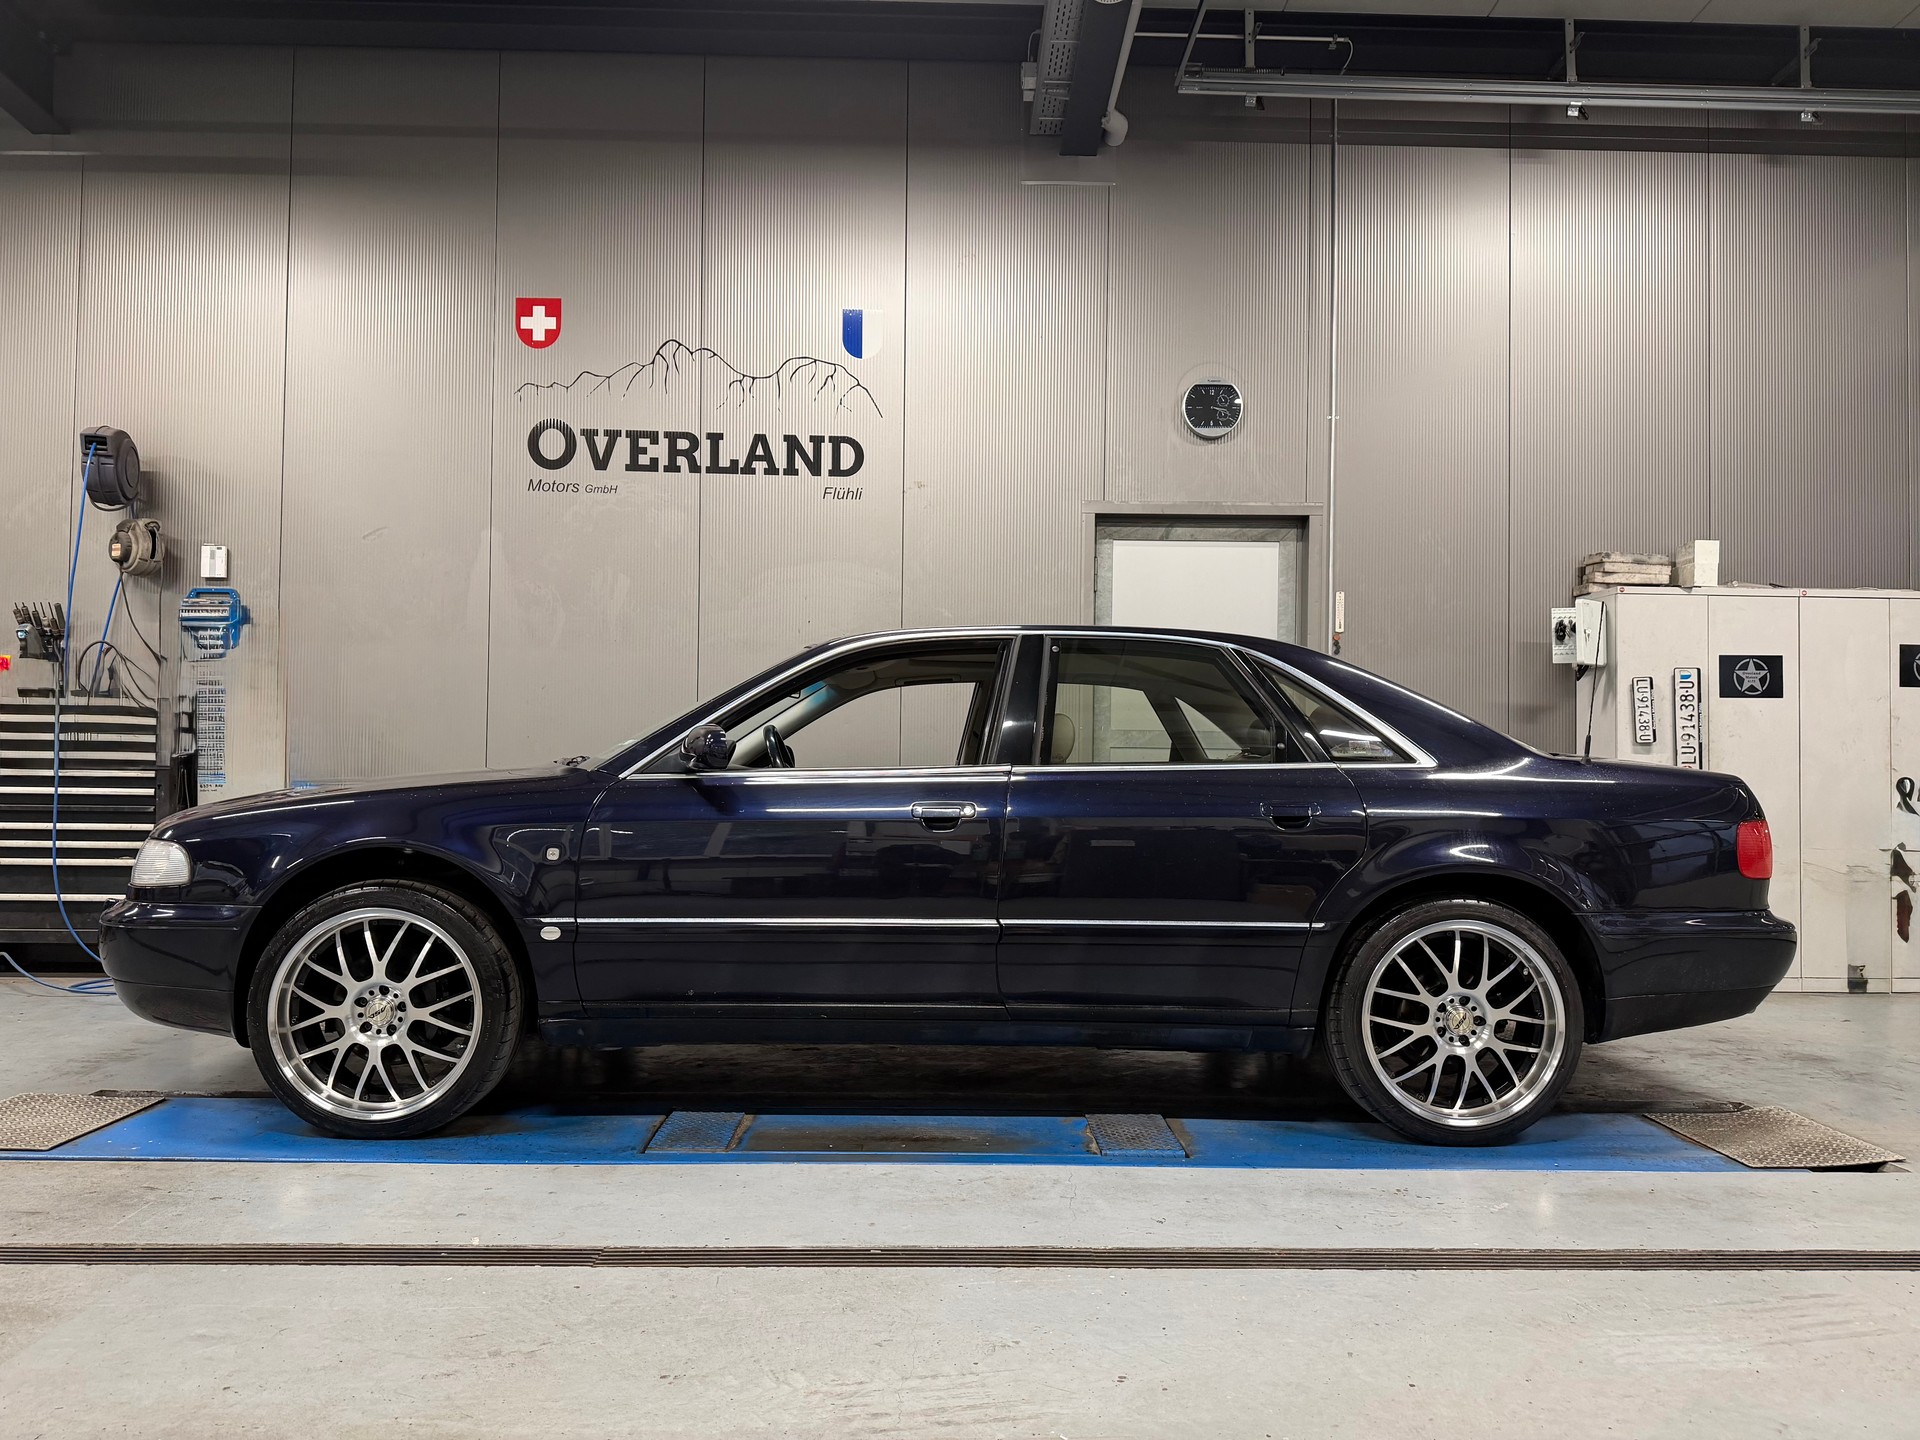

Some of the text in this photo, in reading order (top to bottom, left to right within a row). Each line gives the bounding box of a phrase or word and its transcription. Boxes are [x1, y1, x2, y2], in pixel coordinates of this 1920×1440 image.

[527, 418, 865, 477] OVERLAND
[527, 478, 618, 494] Motors GmbH
[822, 486, 863, 500] Flühli
